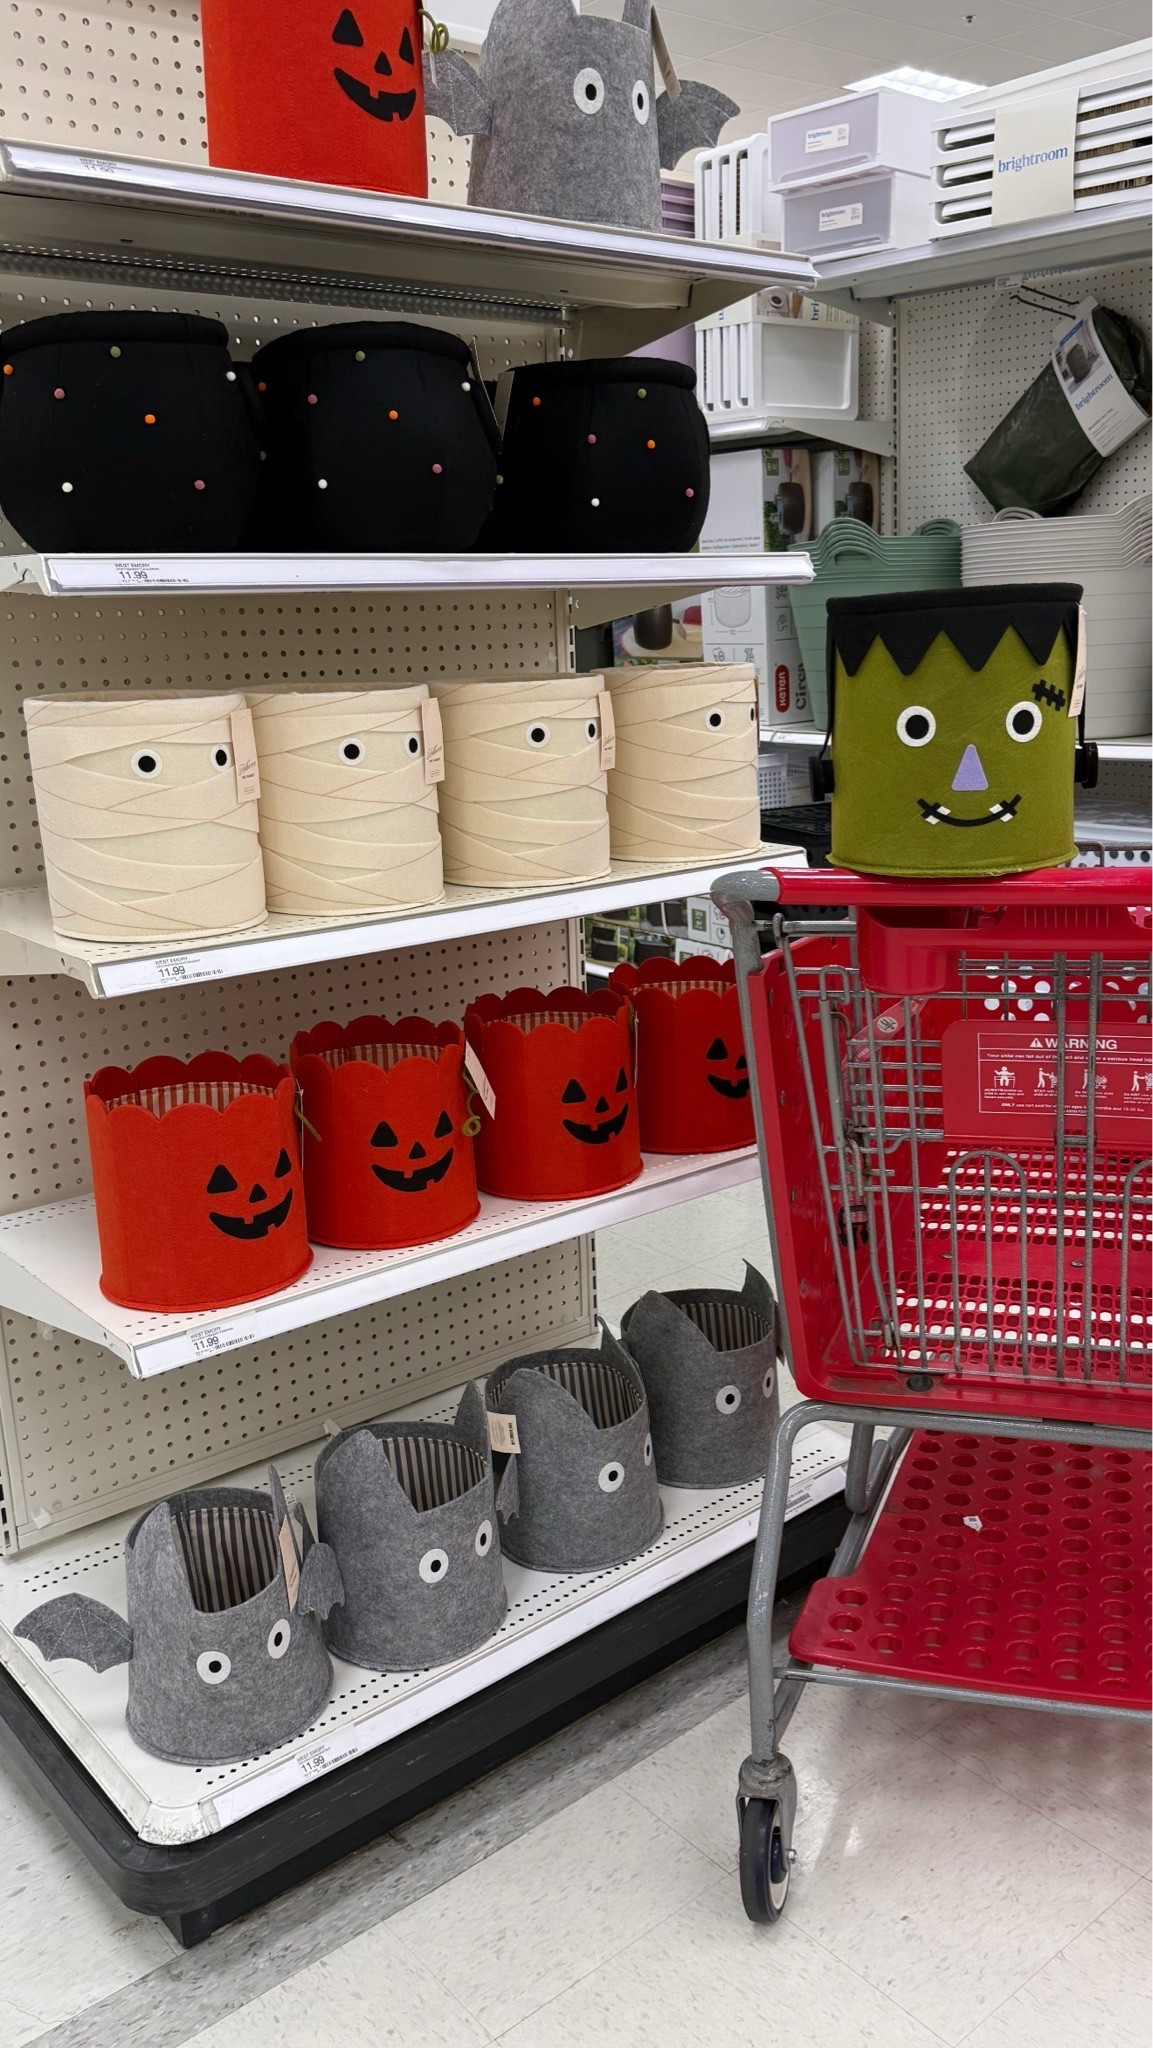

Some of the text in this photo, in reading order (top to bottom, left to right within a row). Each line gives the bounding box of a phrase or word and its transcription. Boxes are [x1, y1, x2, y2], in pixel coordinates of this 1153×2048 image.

[998, 147, 1068, 173] brightroom
[1075, 374, 1113, 411] brightroom
[119, 571, 148, 579] 11.99
[158, 965, 186, 977] 11.99
[194, 1336, 219, 1350] 11.99
[301, 1756, 325, 1772] 11.99
